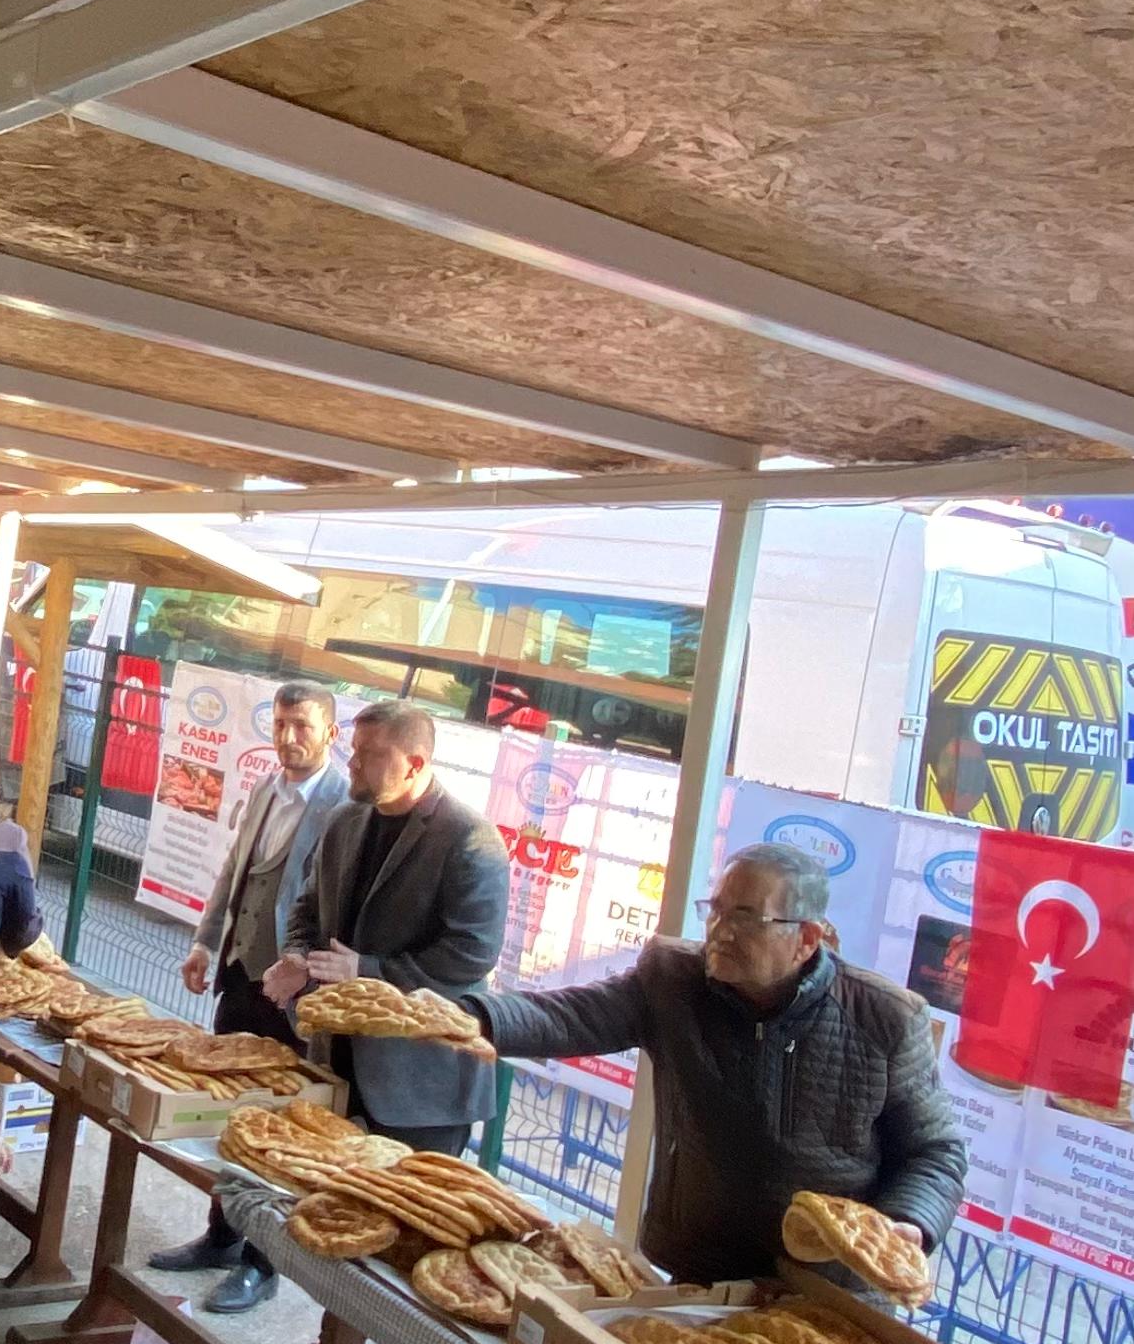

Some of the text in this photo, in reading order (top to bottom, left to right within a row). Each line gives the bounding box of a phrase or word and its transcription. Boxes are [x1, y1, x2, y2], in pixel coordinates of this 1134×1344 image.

[178, 721, 227, 746] KASAP
[972, 711, 1050, 749] OKUL
[180, 741, 219, 764] ENES
